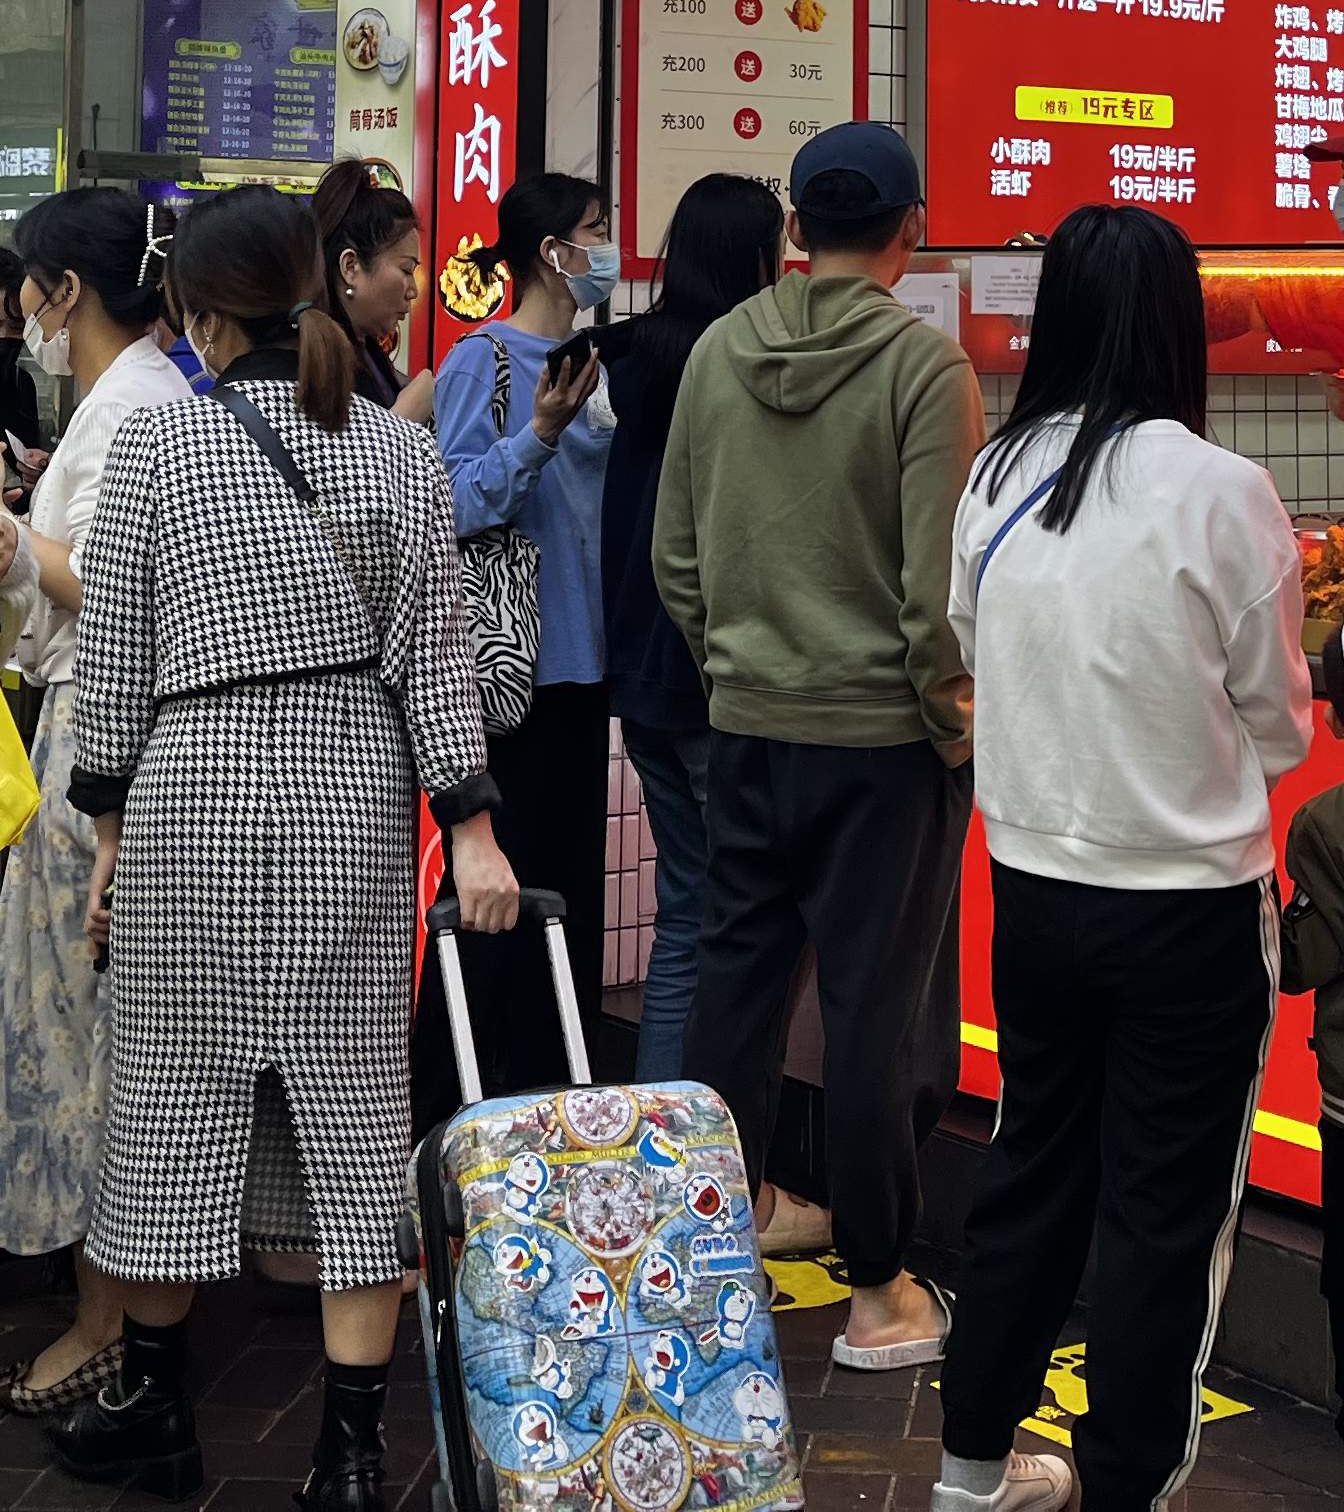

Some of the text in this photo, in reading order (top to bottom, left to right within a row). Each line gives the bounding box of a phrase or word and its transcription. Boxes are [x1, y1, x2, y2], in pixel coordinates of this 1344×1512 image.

[740, 1, 757, 19] 送
[1274, 34, 1328, 62] 大鸡腿
[661, 55, 823, 82] 充200 送 30元
[349, 106, 398, 132] 筒骨汤饭
[1081, 97, 1155, 121] 19元专区
[661, 113, 822, 137] 充300 送 60元
[990, 136, 1196, 172] 小酥肉 19元/半斤
[990, 169, 1197, 204] 活虾 19元/半斤
